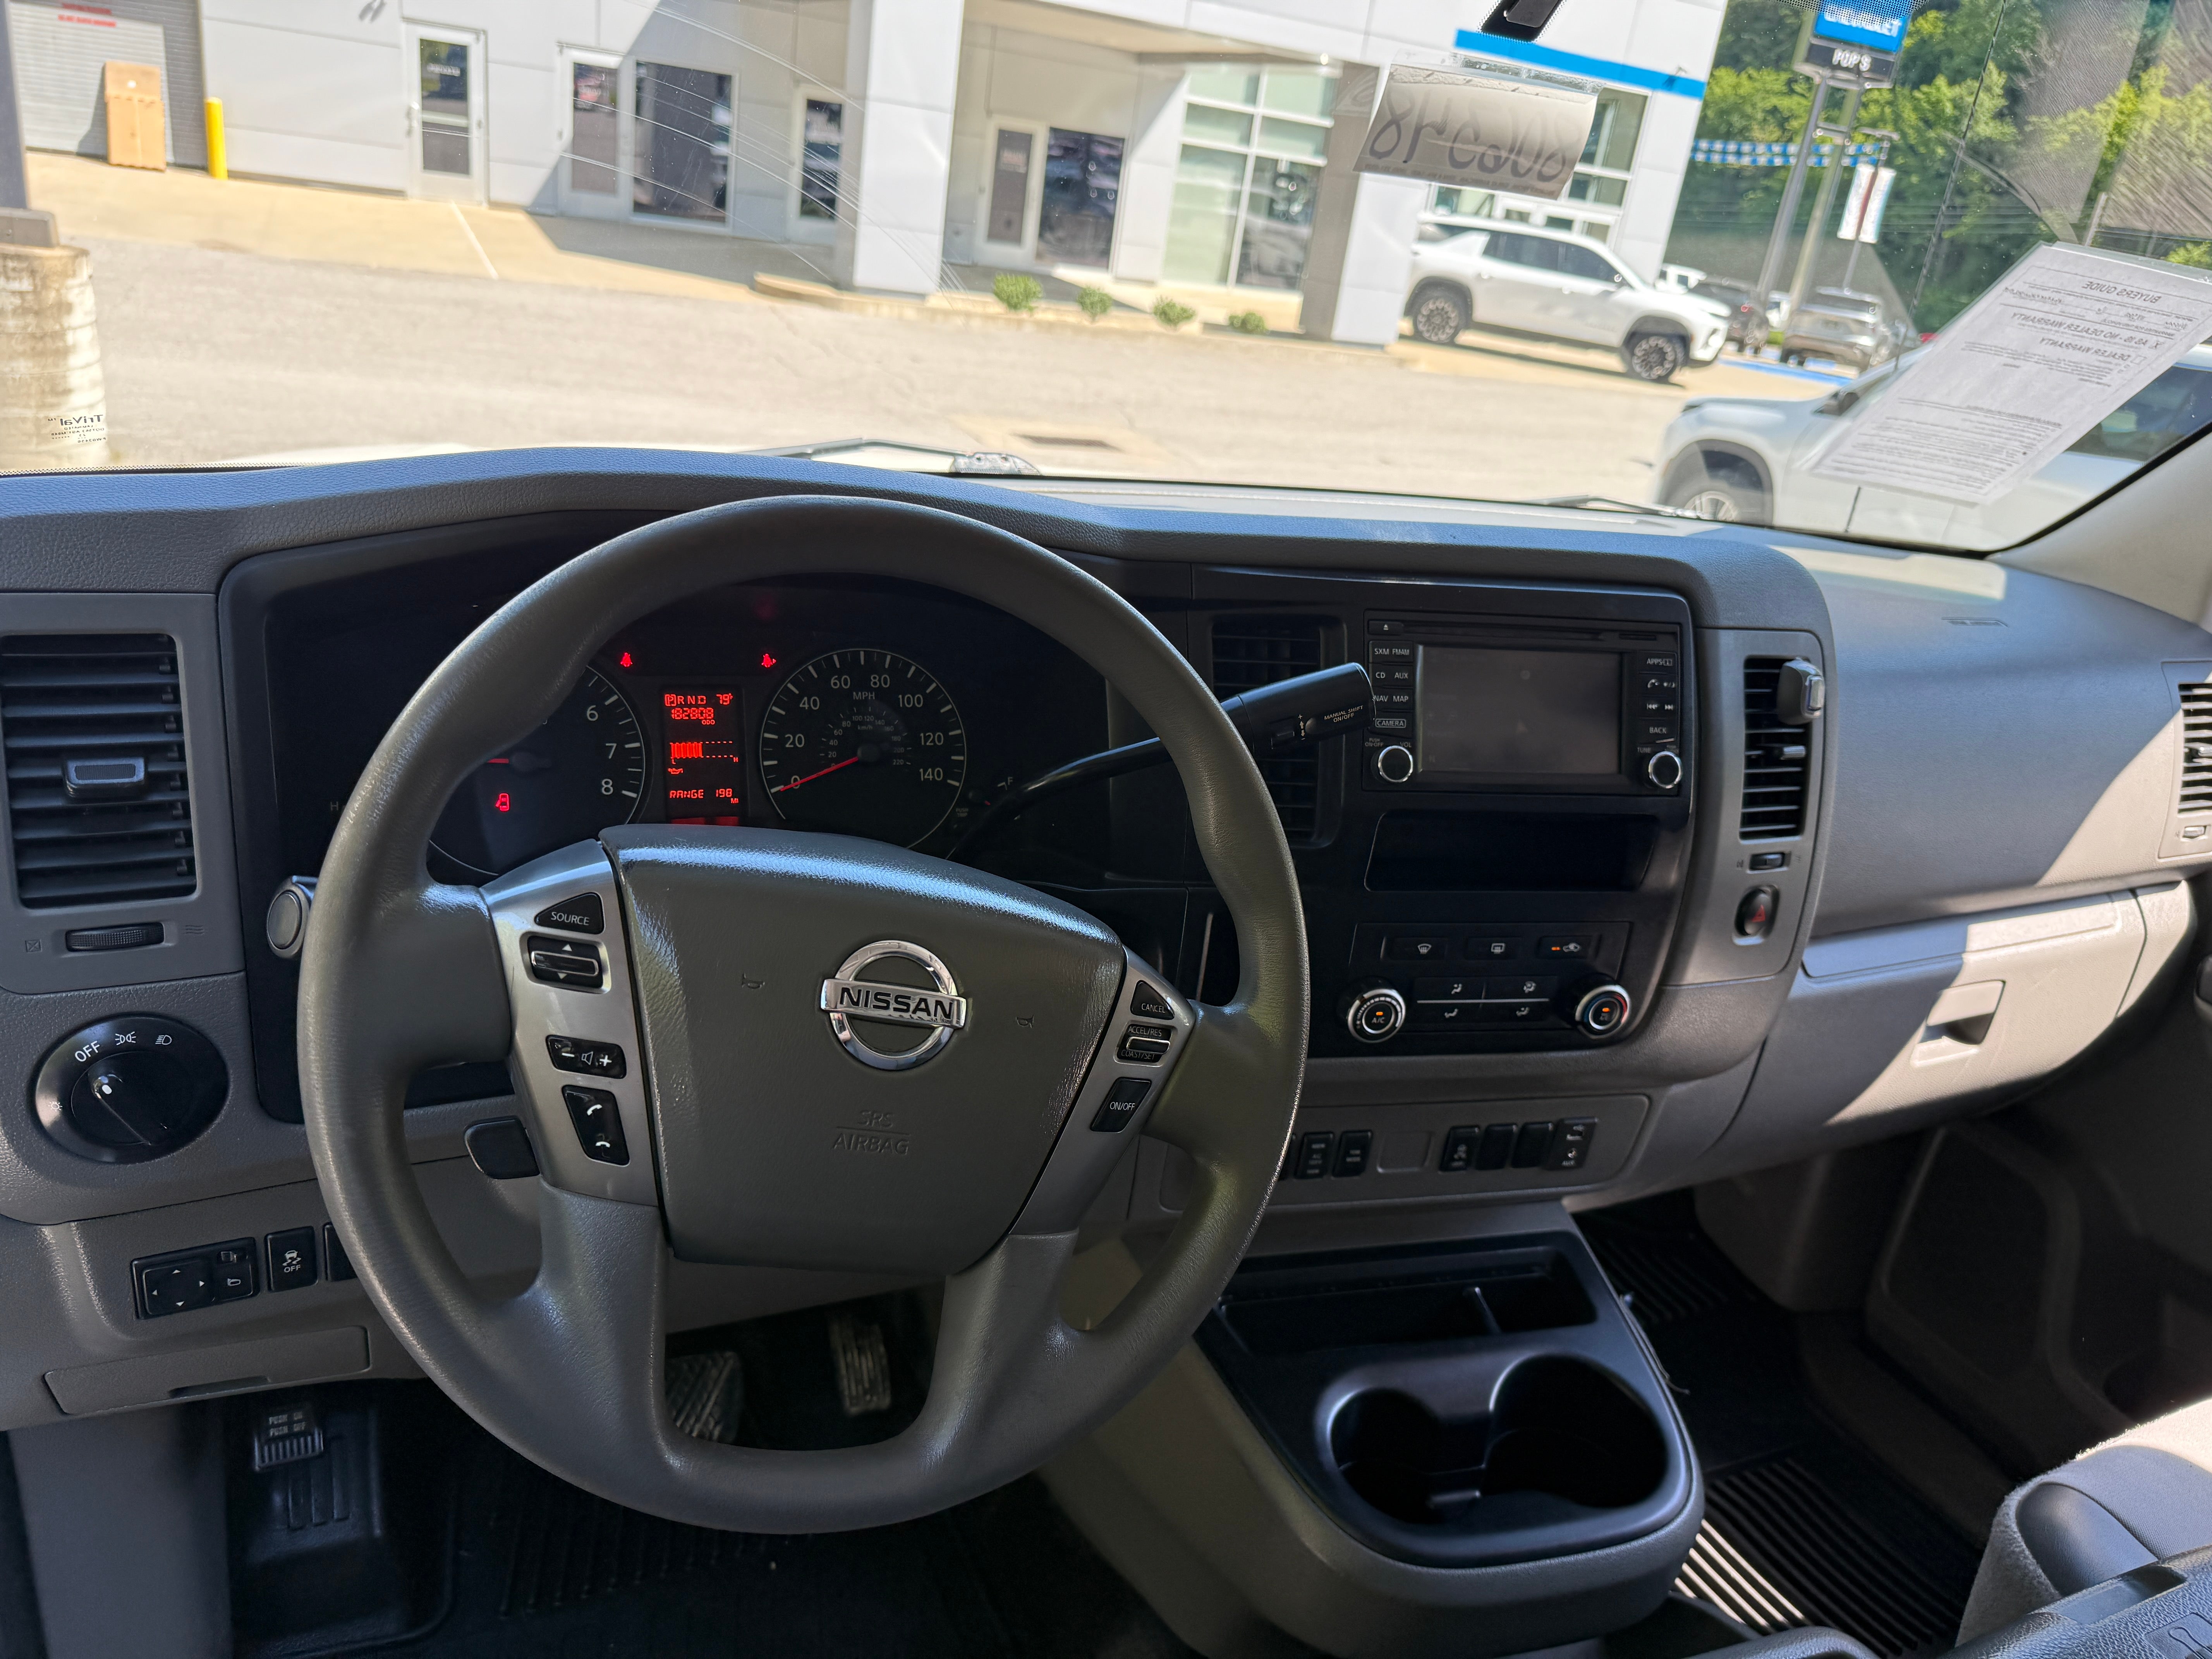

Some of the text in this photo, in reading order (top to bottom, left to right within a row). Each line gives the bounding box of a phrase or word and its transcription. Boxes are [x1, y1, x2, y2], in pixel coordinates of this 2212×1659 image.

[831, 675, 850, 689] 60
[871, 675, 890, 688] 80
[800, 696, 820, 710] 40
[853, 692, 875, 700] MPH
[898, 694, 924, 708] 100
[587, 705, 598, 721] 6
[671, 708, 714, 720] 182808
[1324, 705, 1364, 720] MANUAL SHIFT
[1333, 713, 1355, 723] ON/OFF
[785, 734, 805, 748] 20
[919, 732, 944, 745] 120
[606, 743, 617, 759] 7
[919, 768, 943, 781] 140
[601, 778, 614, 795] 8
[670, 788, 732, 799] RANGE 198
[550, 911, 591, 926] SOURCE
[839, 986, 954, 1021] NISSAN
[1142, 1003, 1166, 1013] CANCEL
[1128, 1026, 1162, 1037] ACCEL/RES
[74, 1040, 100, 1063] OFF
[1121, 1049, 1155, 1060] COAST/SET
[1109, 1101, 1135, 1112] ON/OFF
[858, 1110, 894, 1130] SRS
[832, 1133, 910, 1156] AIRBAG
[283, 1264, 301, 1273] OFF
